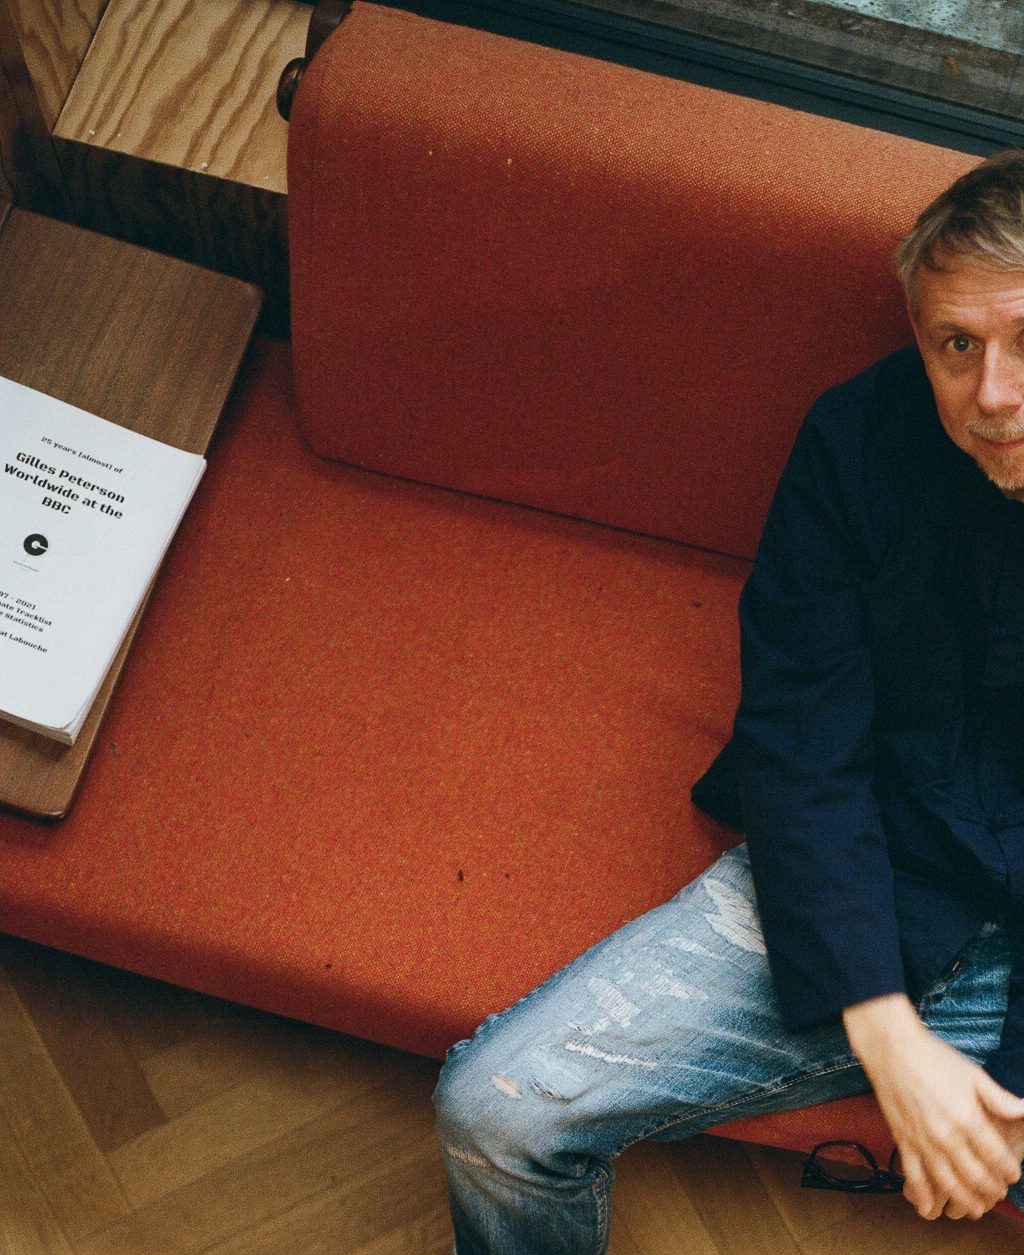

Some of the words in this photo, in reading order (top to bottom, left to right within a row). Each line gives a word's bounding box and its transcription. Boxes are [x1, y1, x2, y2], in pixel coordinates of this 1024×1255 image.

[41, 436, 52, 445] 25
[53, 441, 77, 455] years
[16, 452, 56, 475] Gilles
[59, 469, 126, 503] Peterson
[4, 463, 80, 501] Worldwide
[82, 498, 98, 509] at
[99, 503, 123, 519] the
[41, 496, 71, 515] BBC
[15, 598, 37, 610] 2021
[4, 612, 44, 633] Statistics
[16, 608, 52, 627] Tracklist
[9, 634, 48, 653] Labouche
